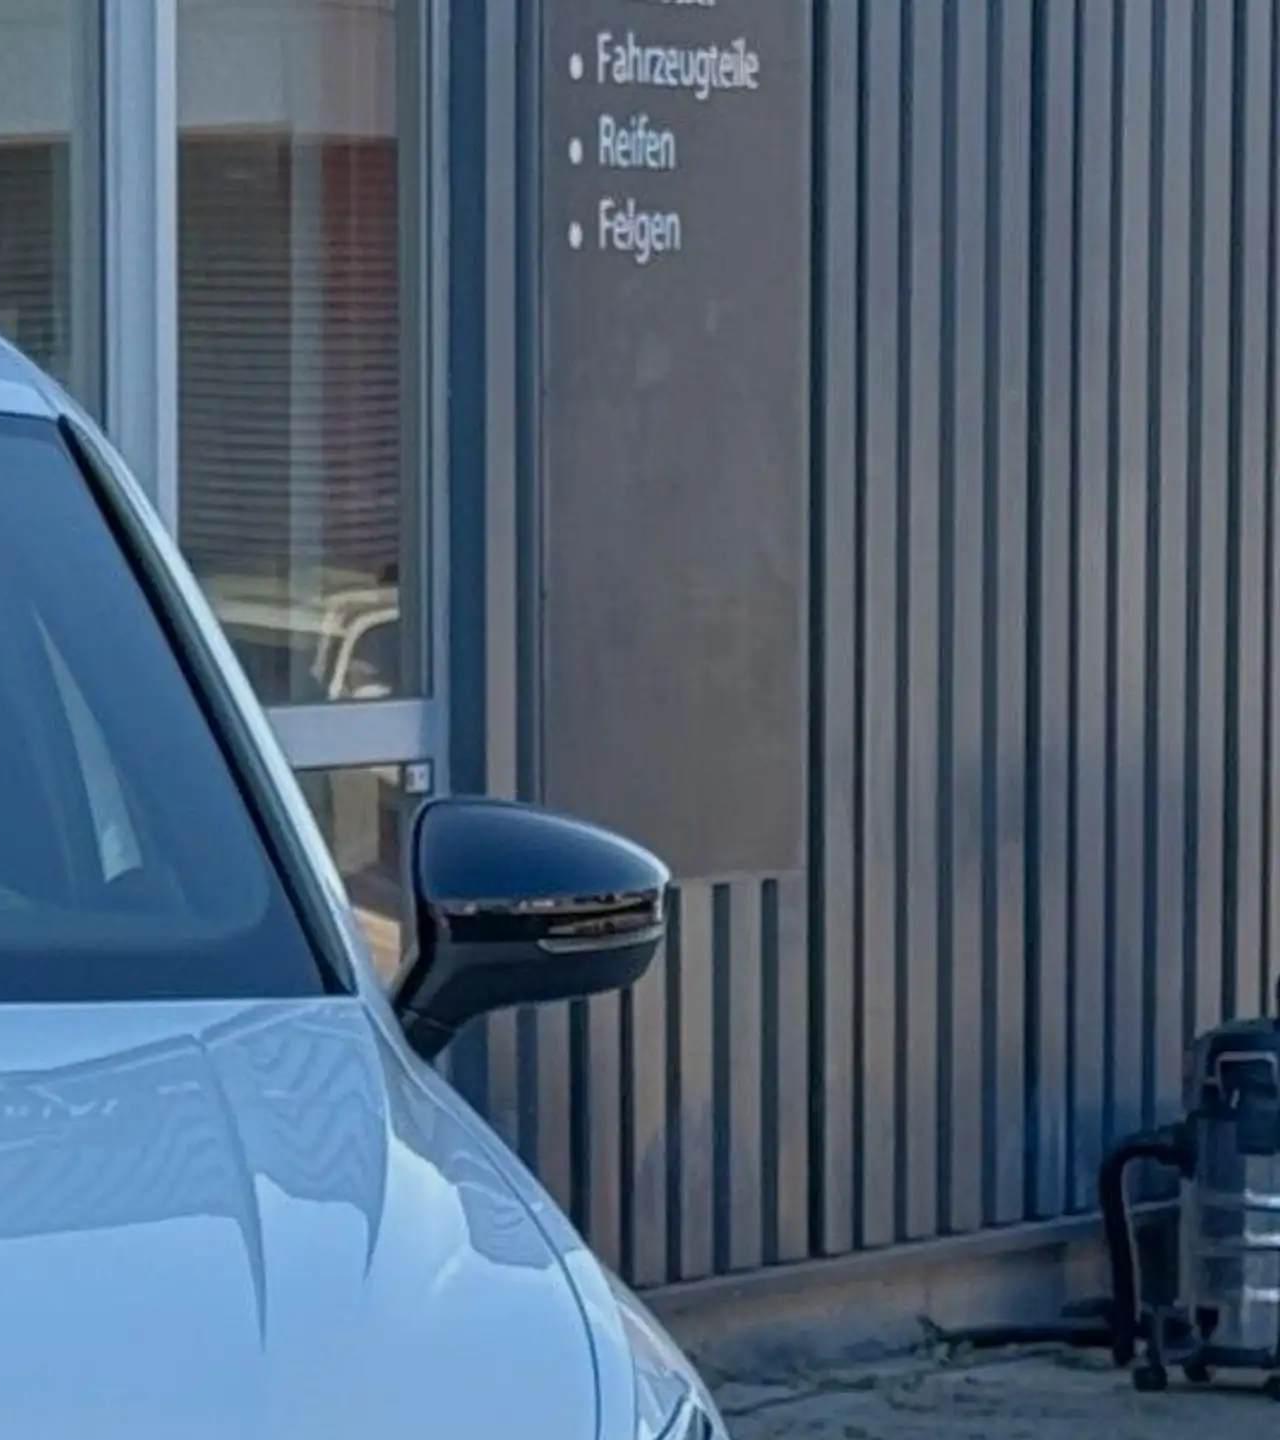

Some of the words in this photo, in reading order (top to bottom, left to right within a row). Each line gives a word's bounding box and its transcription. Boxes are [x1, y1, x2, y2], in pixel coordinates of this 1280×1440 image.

[596, 31, 760, 100] Fahrzeugteile
[598, 113, 676, 169] Reifen
[598, 197, 682, 264] Felgen
